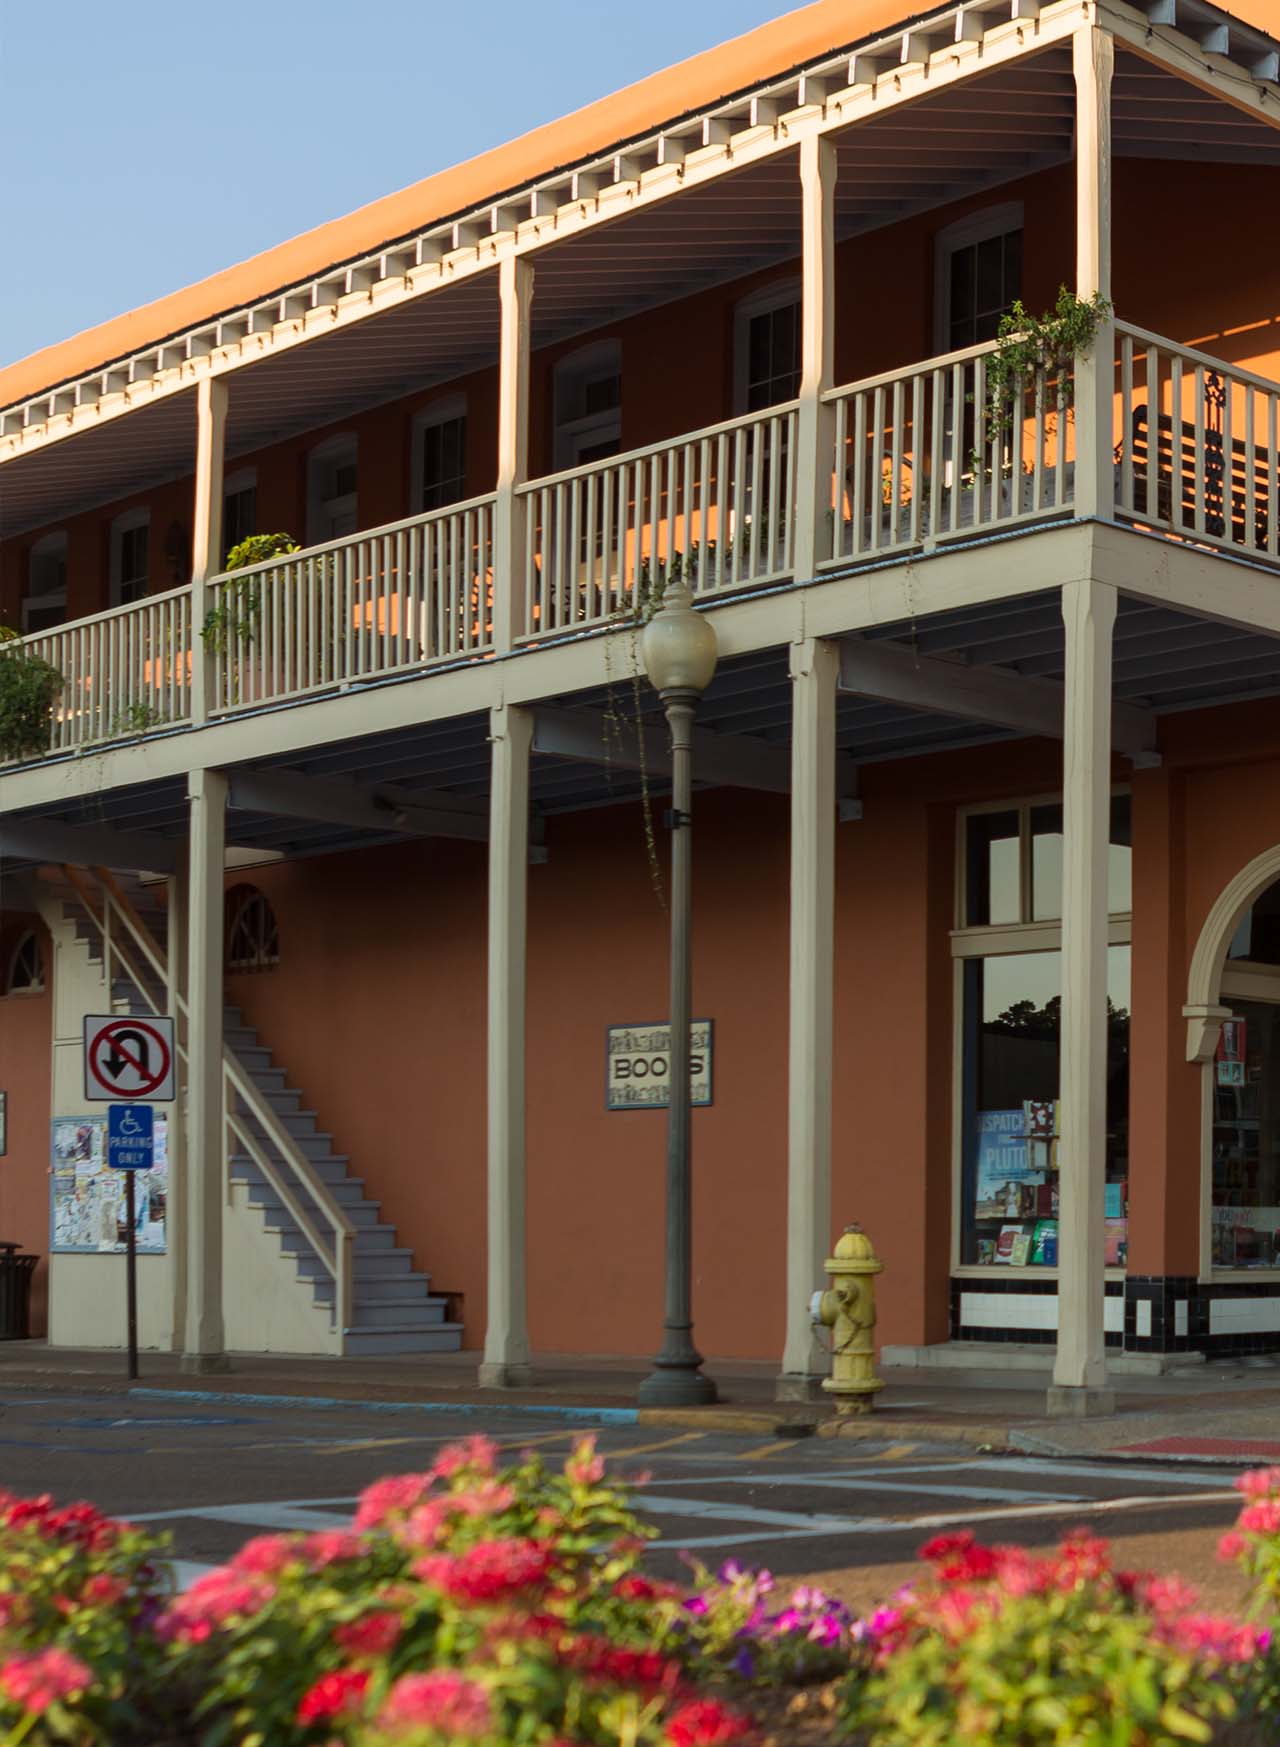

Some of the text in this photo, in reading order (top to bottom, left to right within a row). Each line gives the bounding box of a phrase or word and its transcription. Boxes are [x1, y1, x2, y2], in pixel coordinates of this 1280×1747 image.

[614, 1055, 704, 1079] BOOS
[110, 1136, 153, 1149] PARKING
[118, 1152, 145, 1164] ONLY
